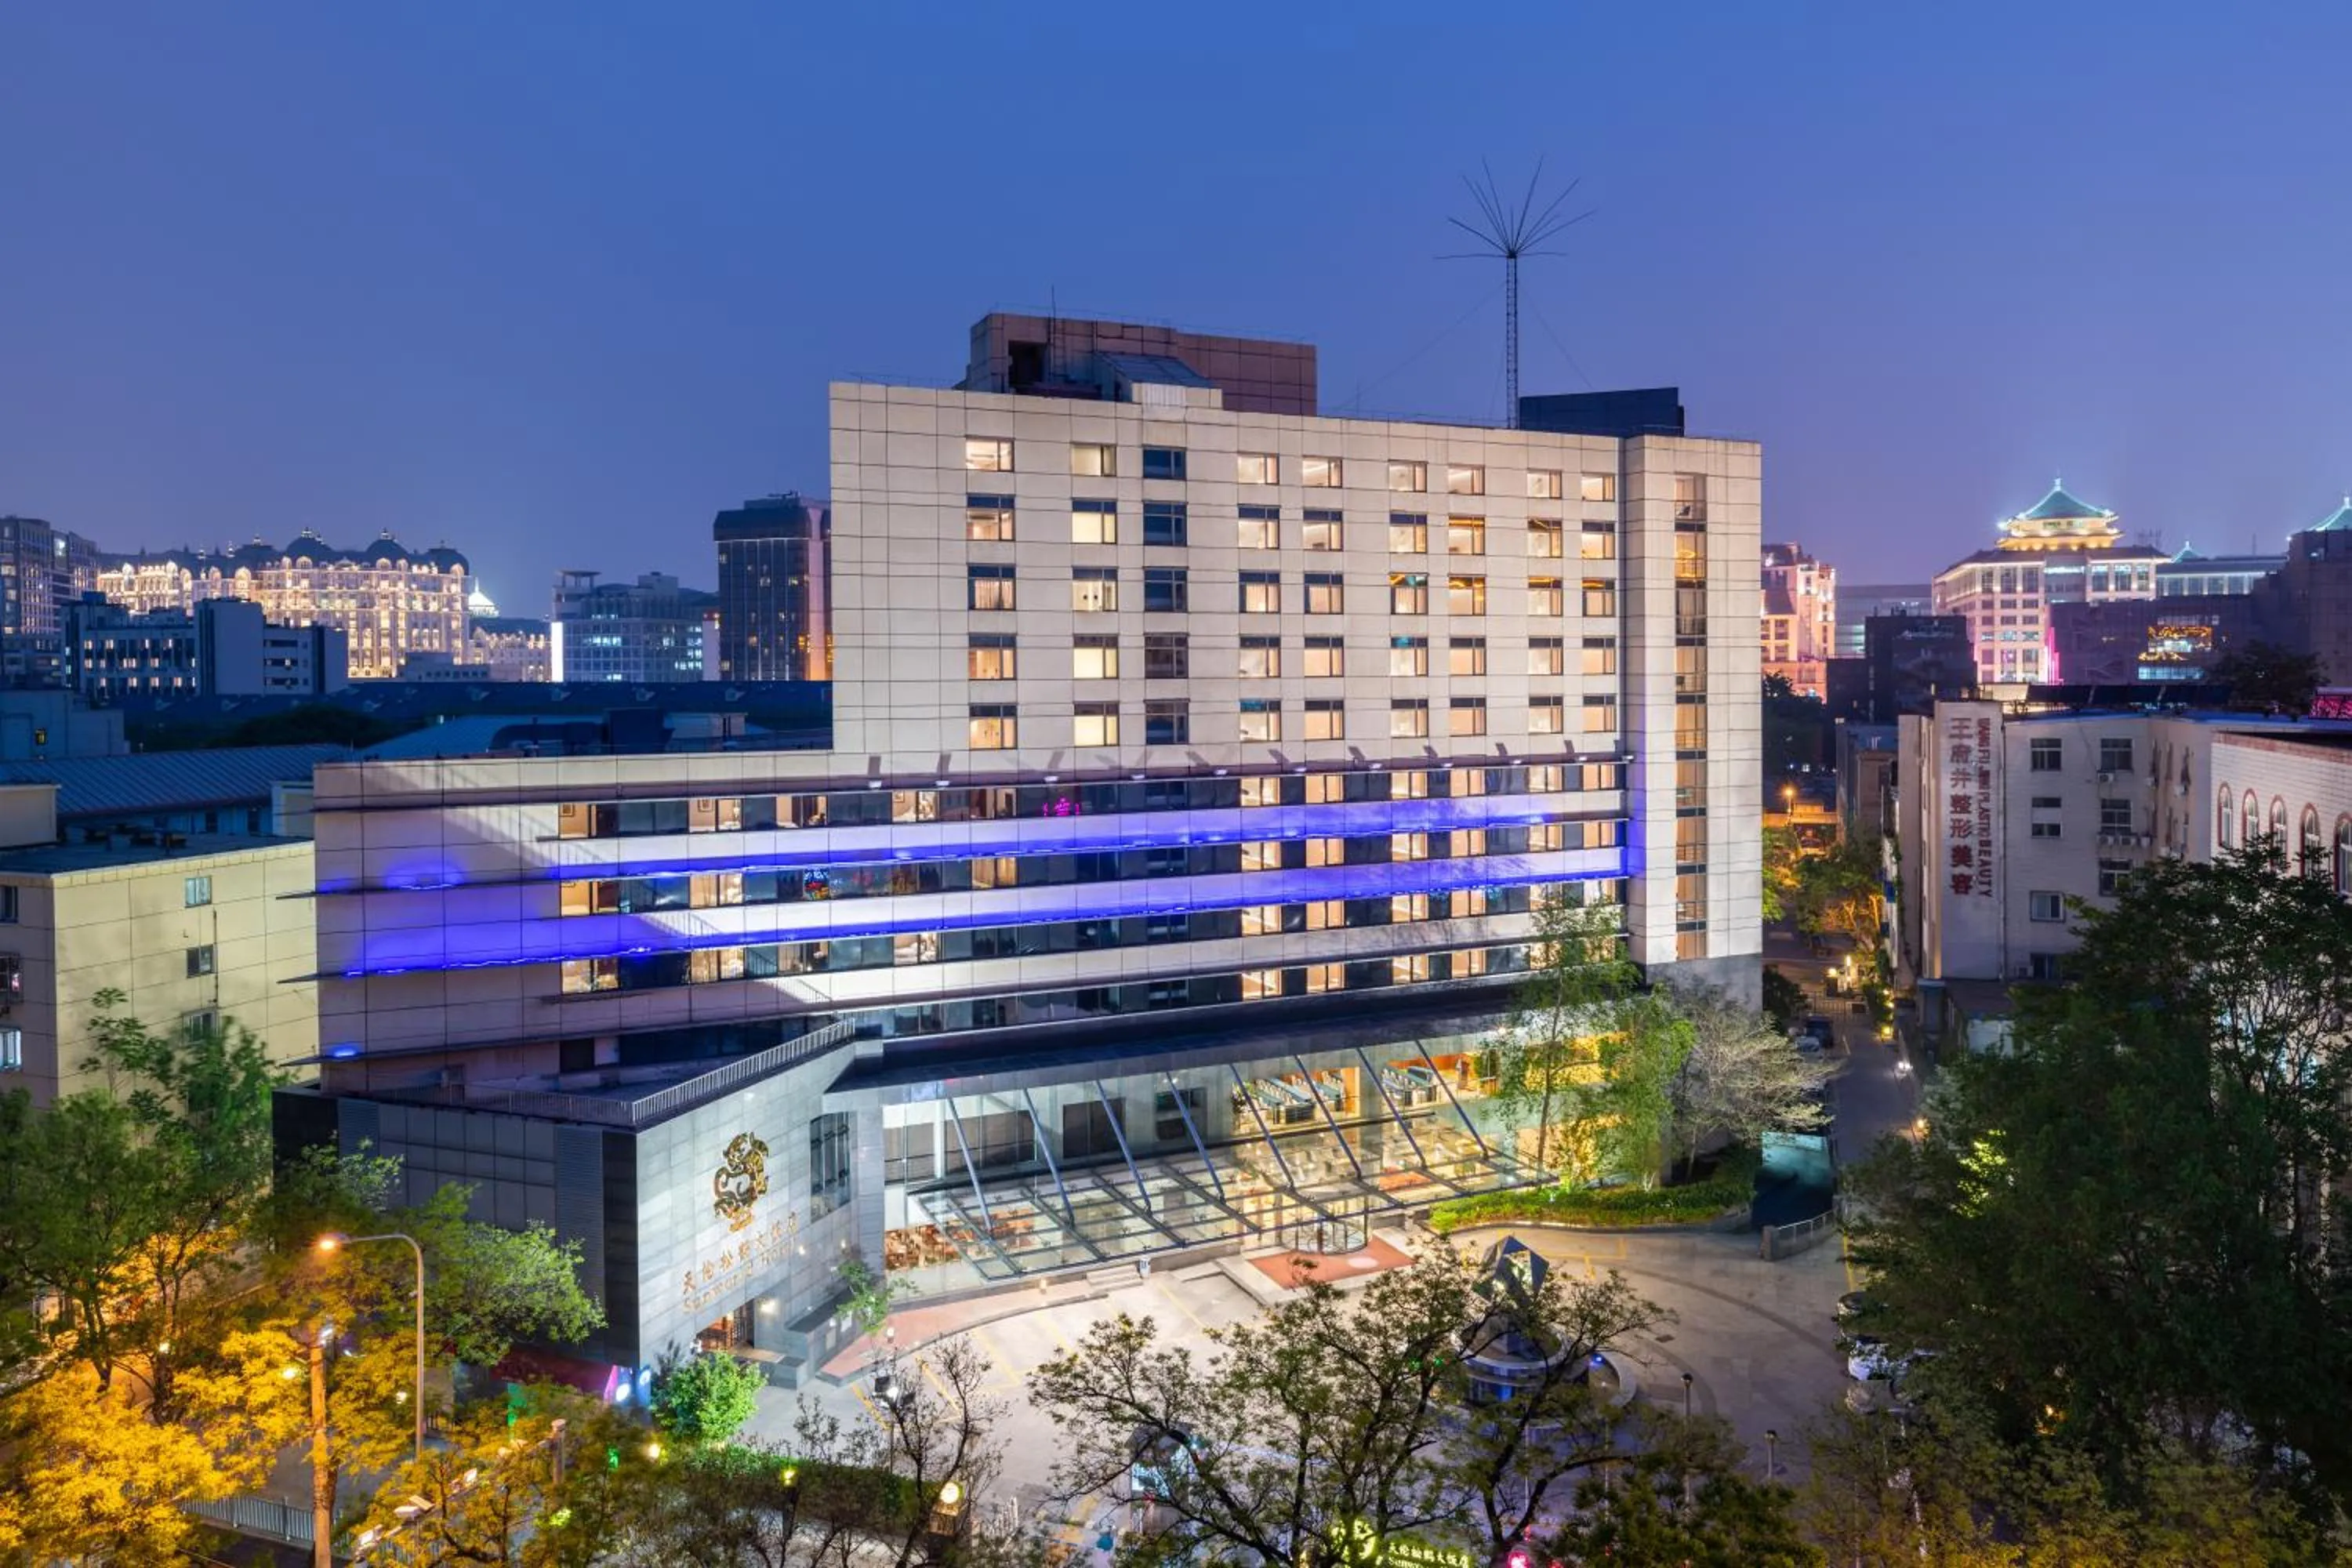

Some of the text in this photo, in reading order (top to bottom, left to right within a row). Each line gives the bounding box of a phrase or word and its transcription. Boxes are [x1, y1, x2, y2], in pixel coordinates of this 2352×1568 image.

[1948, 717, 1973, 895] 王府井整形美容
[1977, 791, 1991, 838] PLASTIC
[1978, 840, 1992, 898] BEAUTY
